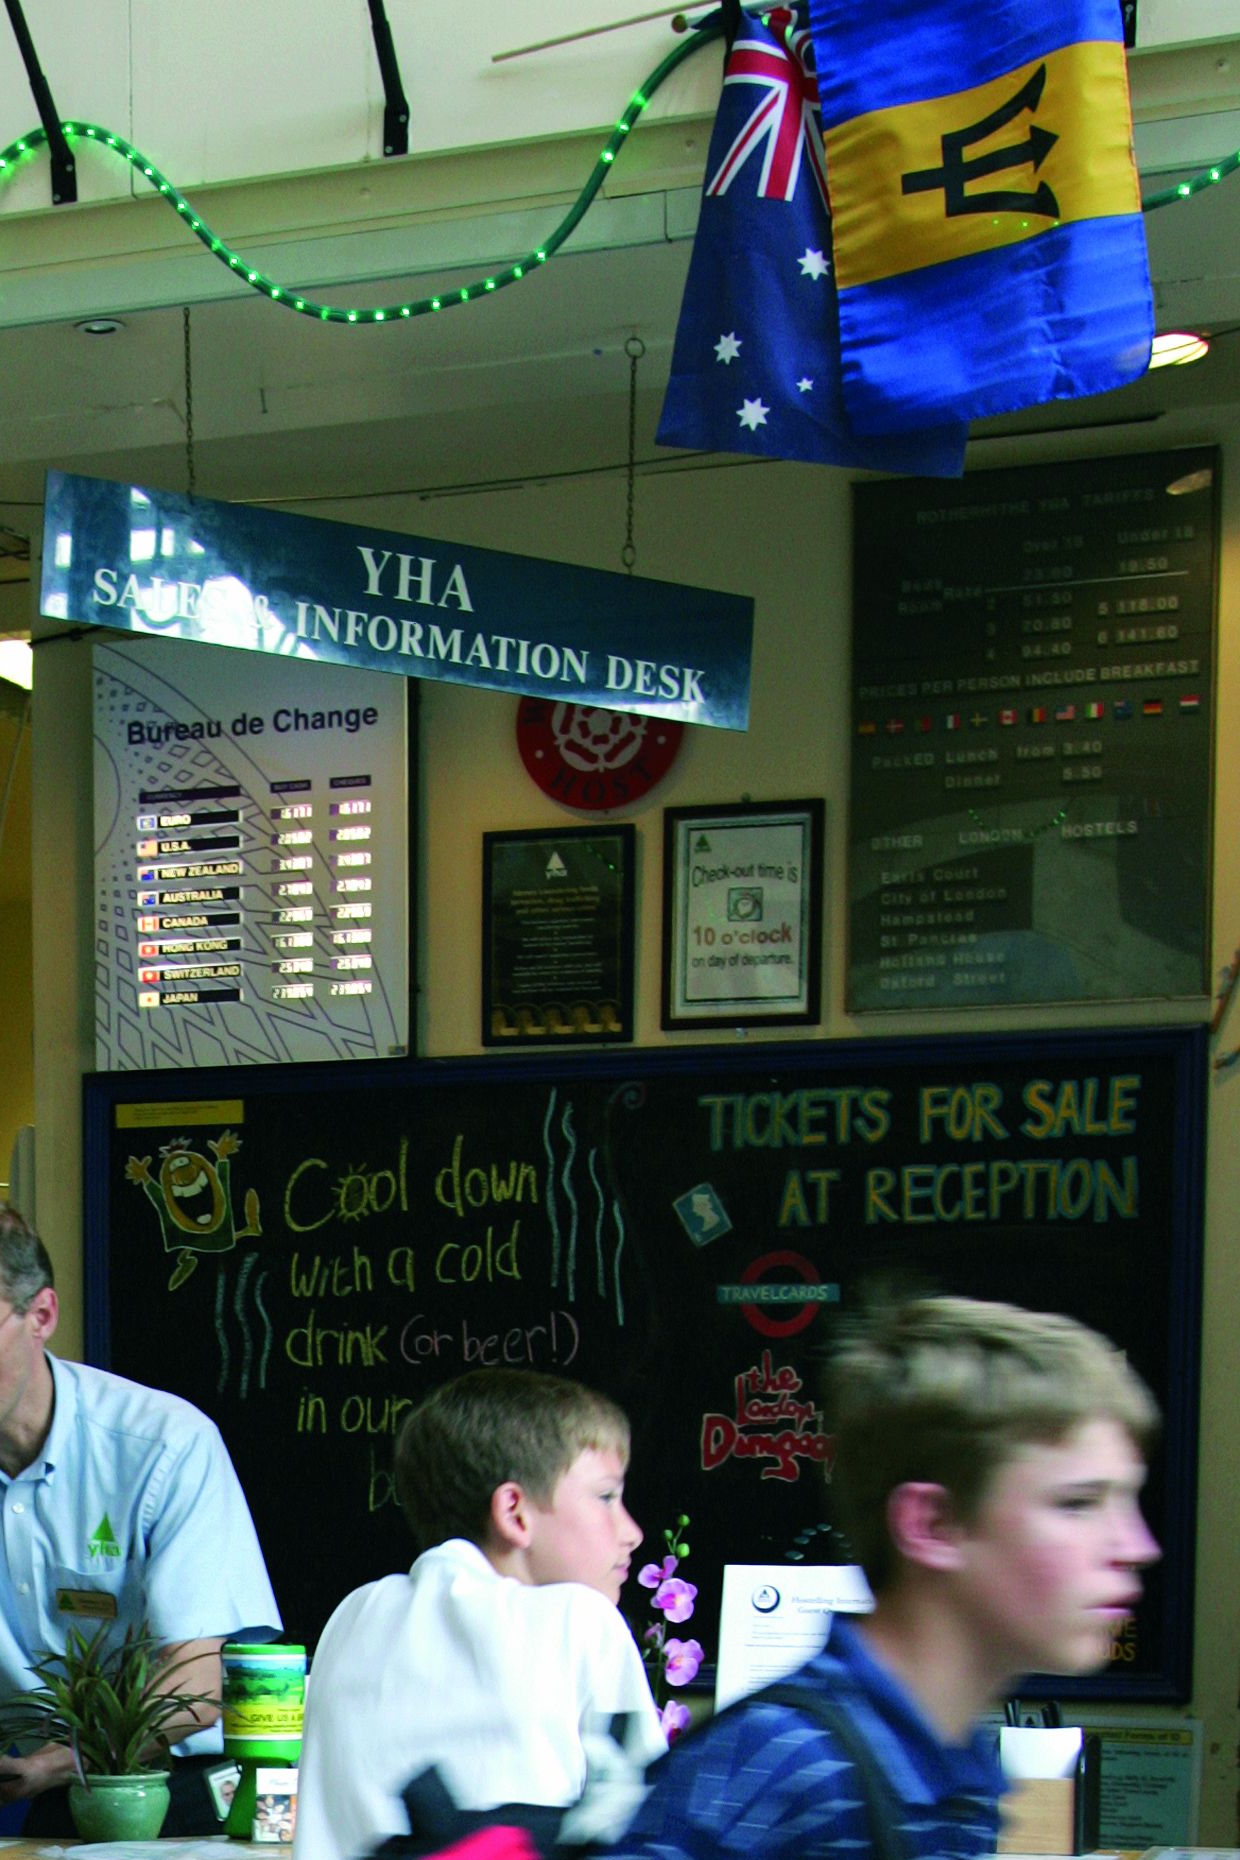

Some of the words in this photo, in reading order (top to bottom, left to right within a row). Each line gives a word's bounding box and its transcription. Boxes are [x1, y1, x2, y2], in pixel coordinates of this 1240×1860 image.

[357, 545, 475, 613] YHA
[249, 595, 275, 629] &
[296, 601, 589, 684] INFORMATION
[606, 654, 707, 704] DESK
[858, 683, 918, 701] PRICES
[921, 679, 954, 696] PER
[956, 674, 1021, 693] PERSON
[1025, 668, 1097, 687] INCLUDE
[1099, 659, 1200, 681] BREAKFAST
[127, 713, 222, 746] Bureau
[231, 712, 265, 736] de
[273, 705, 379, 733] Change
[160, 814, 192, 827] EURO
[957, 828, 1025, 847] LONDON
[1060, 820, 1139, 839] HOSTELS
[161, 865, 187, 878] NEW
[188, 863, 240, 877] ZEALAND
[691, 863, 755, 888] Check-out
[757, 862, 785, 883] time
[786, 860, 799, 883] is
[932, 865, 979, 883] Court
[163, 890, 224, 904] AUSTRALIA
[943, 886, 1008, 903] London
[162, 915, 209, 928] CANADA
[692, 924, 716, 946] 10
[721, 921, 793, 946] o'clock
[162, 941, 194, 954] HONG
[196, 939, 228, 952] KONG
[163, 964, 240, 981] SWITZERLAND
[691, 955, 706, 968] on
[708, 953, 728, 970] day
[729, 951, 740, 967] of
[162, 992, 198, 1004] JAPAN
[698, 1087, 894, 1152] TICKETS
[919, 1082, 1008, 1143] FOR
[1022, 1074, 1142, 1142] SALE
[283, 1135, 409, 1232] Cool
[434, 1134, 539, 1218] down
[777, 1169, 841, 1228] AT
[865, 1155, 1139, 1226] RECEPTION
[387, 1246, 416, 1293] a
[435, 1218, 522, 1285] cold
[721, 1285, 829, 1301] TRAVELCARDS
[284, 1308, 389, 1367] drink
[399, 1313, 454, 1366] (or
[462, 1310, 581, 1366] beer!)
[746, 1349, 803, 1395] the
[297, 1387, 327, 1434] in
[340, 1394, 413, 1434] our
[735, 1375, 818, 1430] London
[87, 1540, 122, 1558] yha
